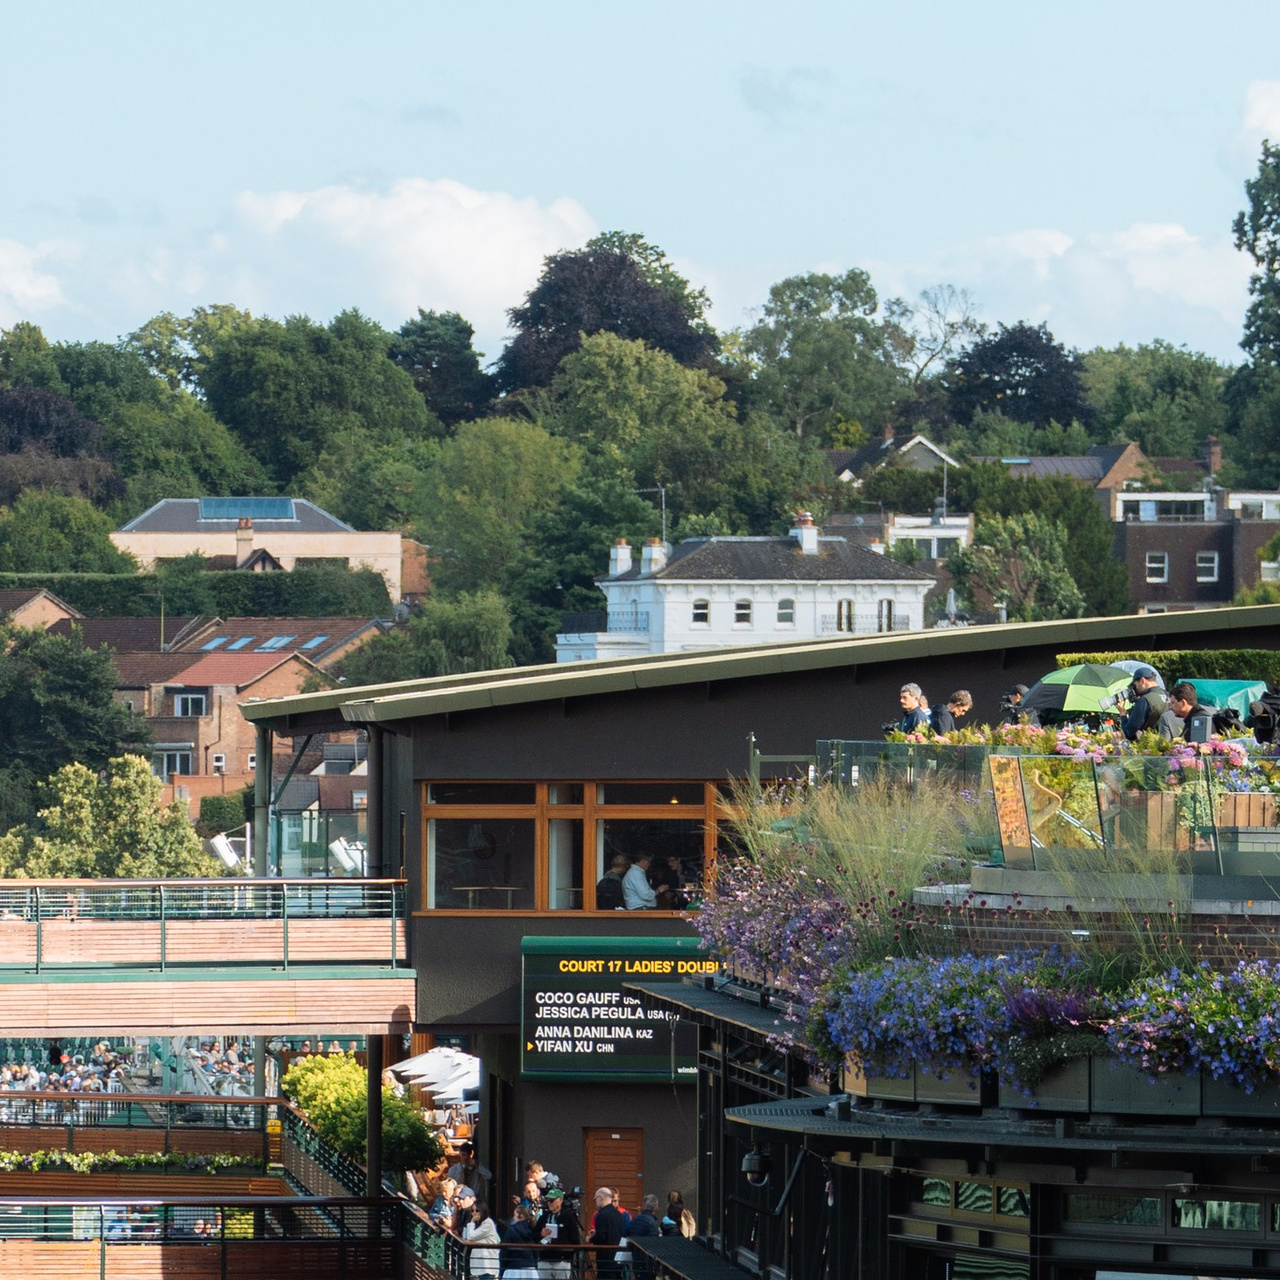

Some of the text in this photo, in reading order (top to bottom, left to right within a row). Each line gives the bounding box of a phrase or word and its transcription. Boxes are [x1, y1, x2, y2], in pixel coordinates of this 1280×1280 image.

[559, 960, 605, 973] COURT
[608, 960, 622, 973] 17
[625, 960, 675, 973] LADIES'
[535, 992, 573, 1005] COCO
[576, 992, 620, 1005] GAUFF
[535, 1006, 589, 1019] JESSICA
[591, 1006, 644, 1019] PEGULA
[647, 1010, 664, 1019] USA
[535, 1026, 653, 1039] ANNA DANILINA KAZ
[535, 1040, 614, 1053] YIFAN XU CHN
